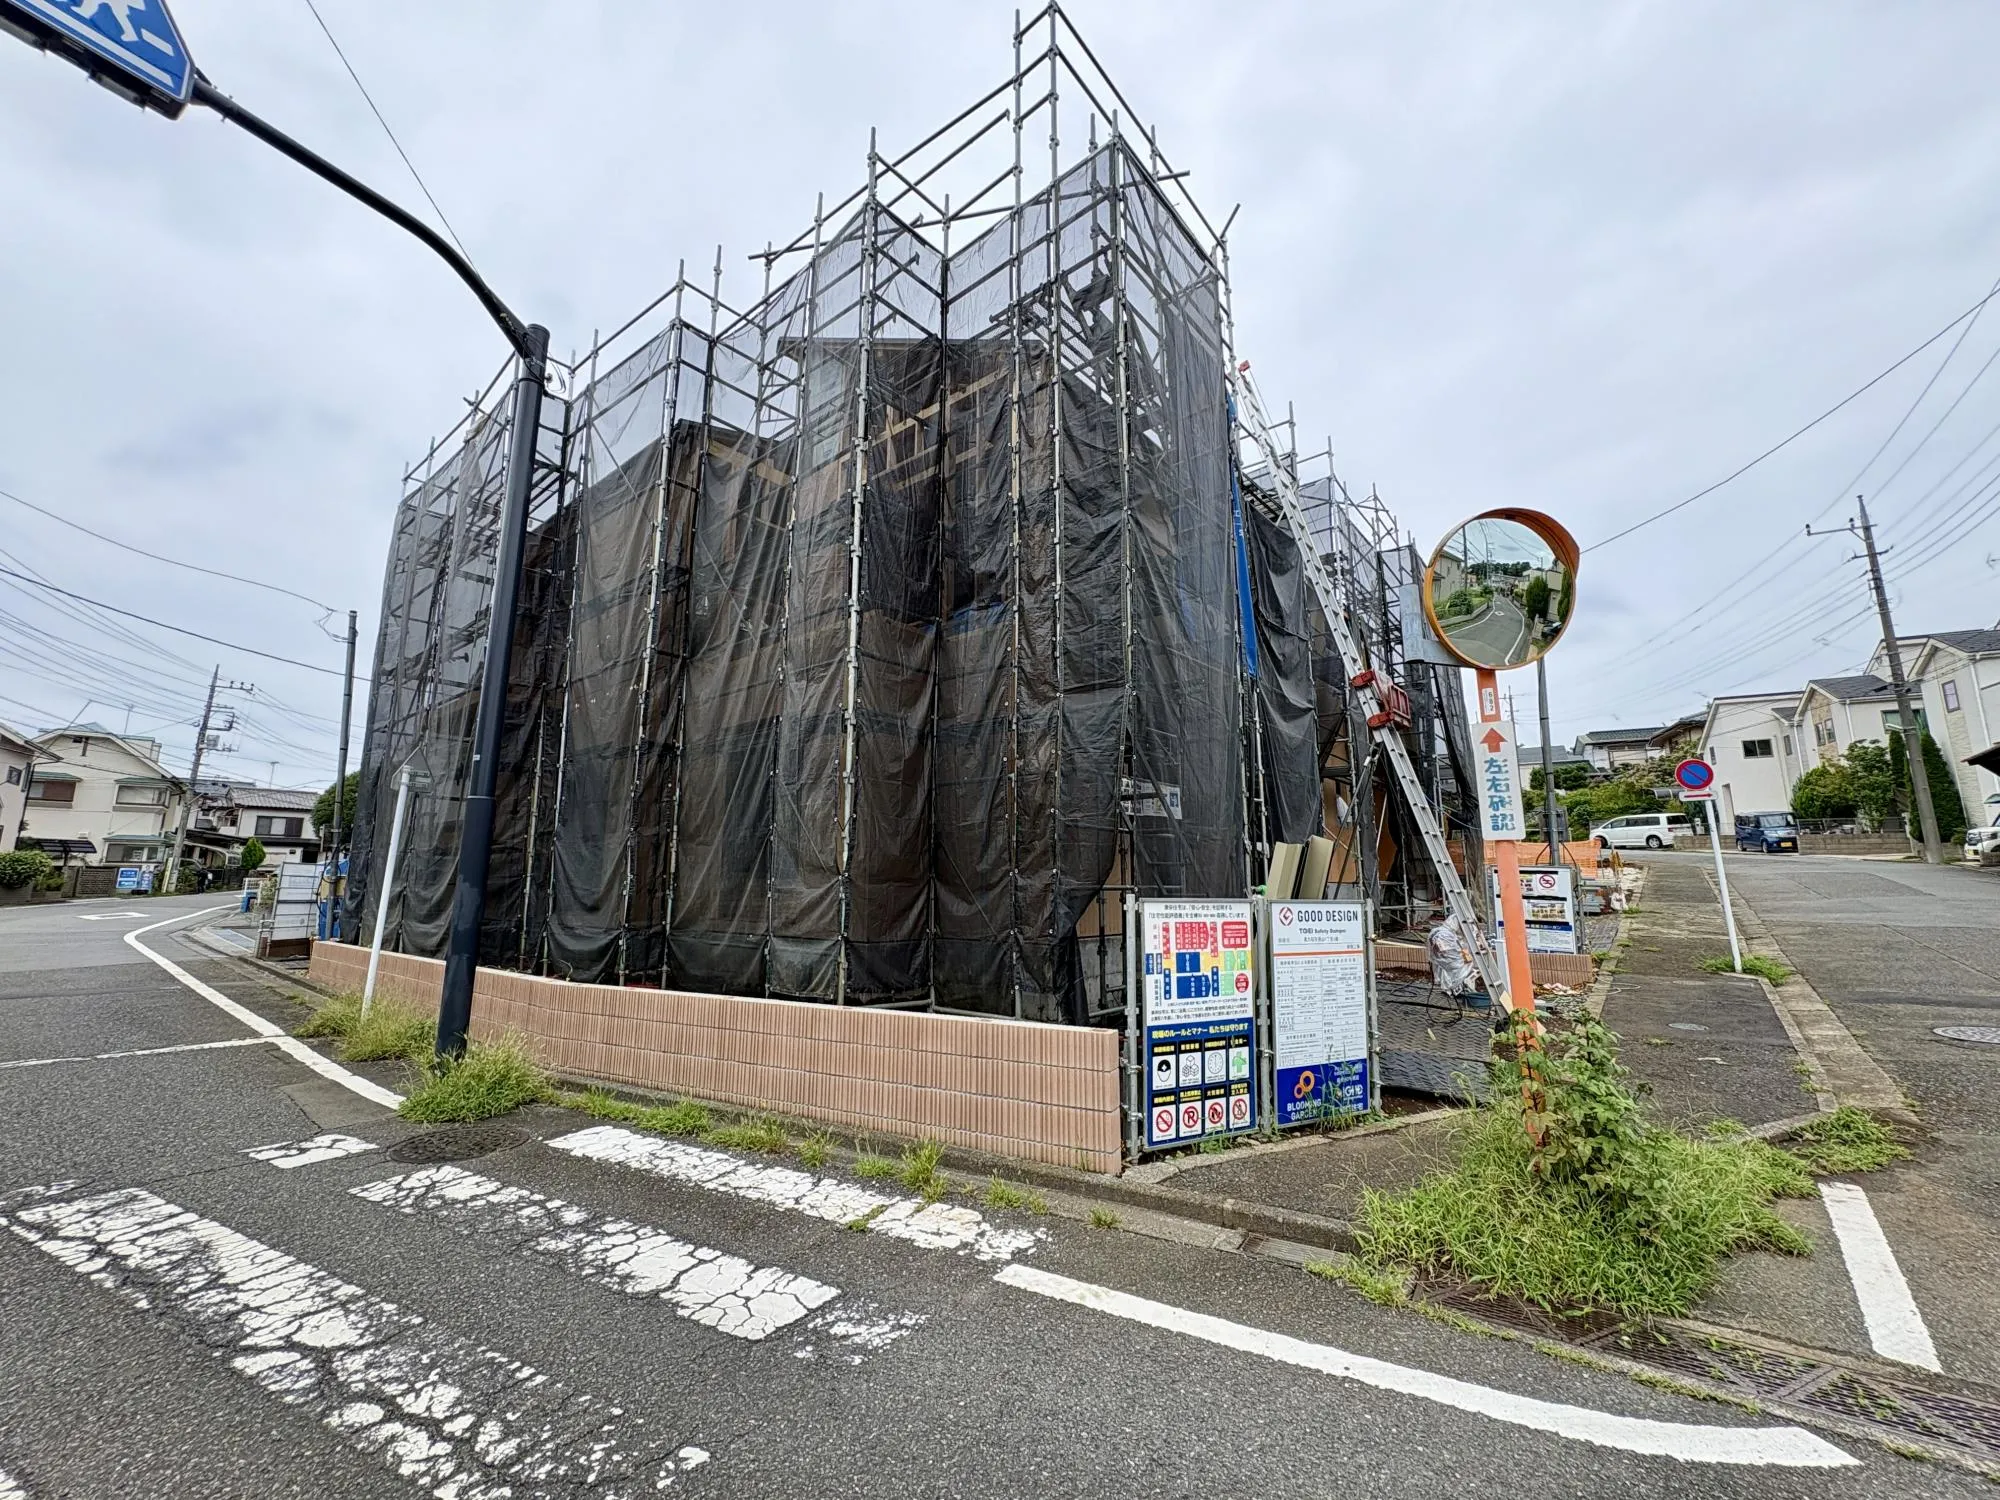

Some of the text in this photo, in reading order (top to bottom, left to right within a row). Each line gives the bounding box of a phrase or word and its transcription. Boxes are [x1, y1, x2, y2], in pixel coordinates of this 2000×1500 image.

[1484, 757, 1516, 831] 左右確認
[1297, 910, 1358, 922] GOOD DESIGN
